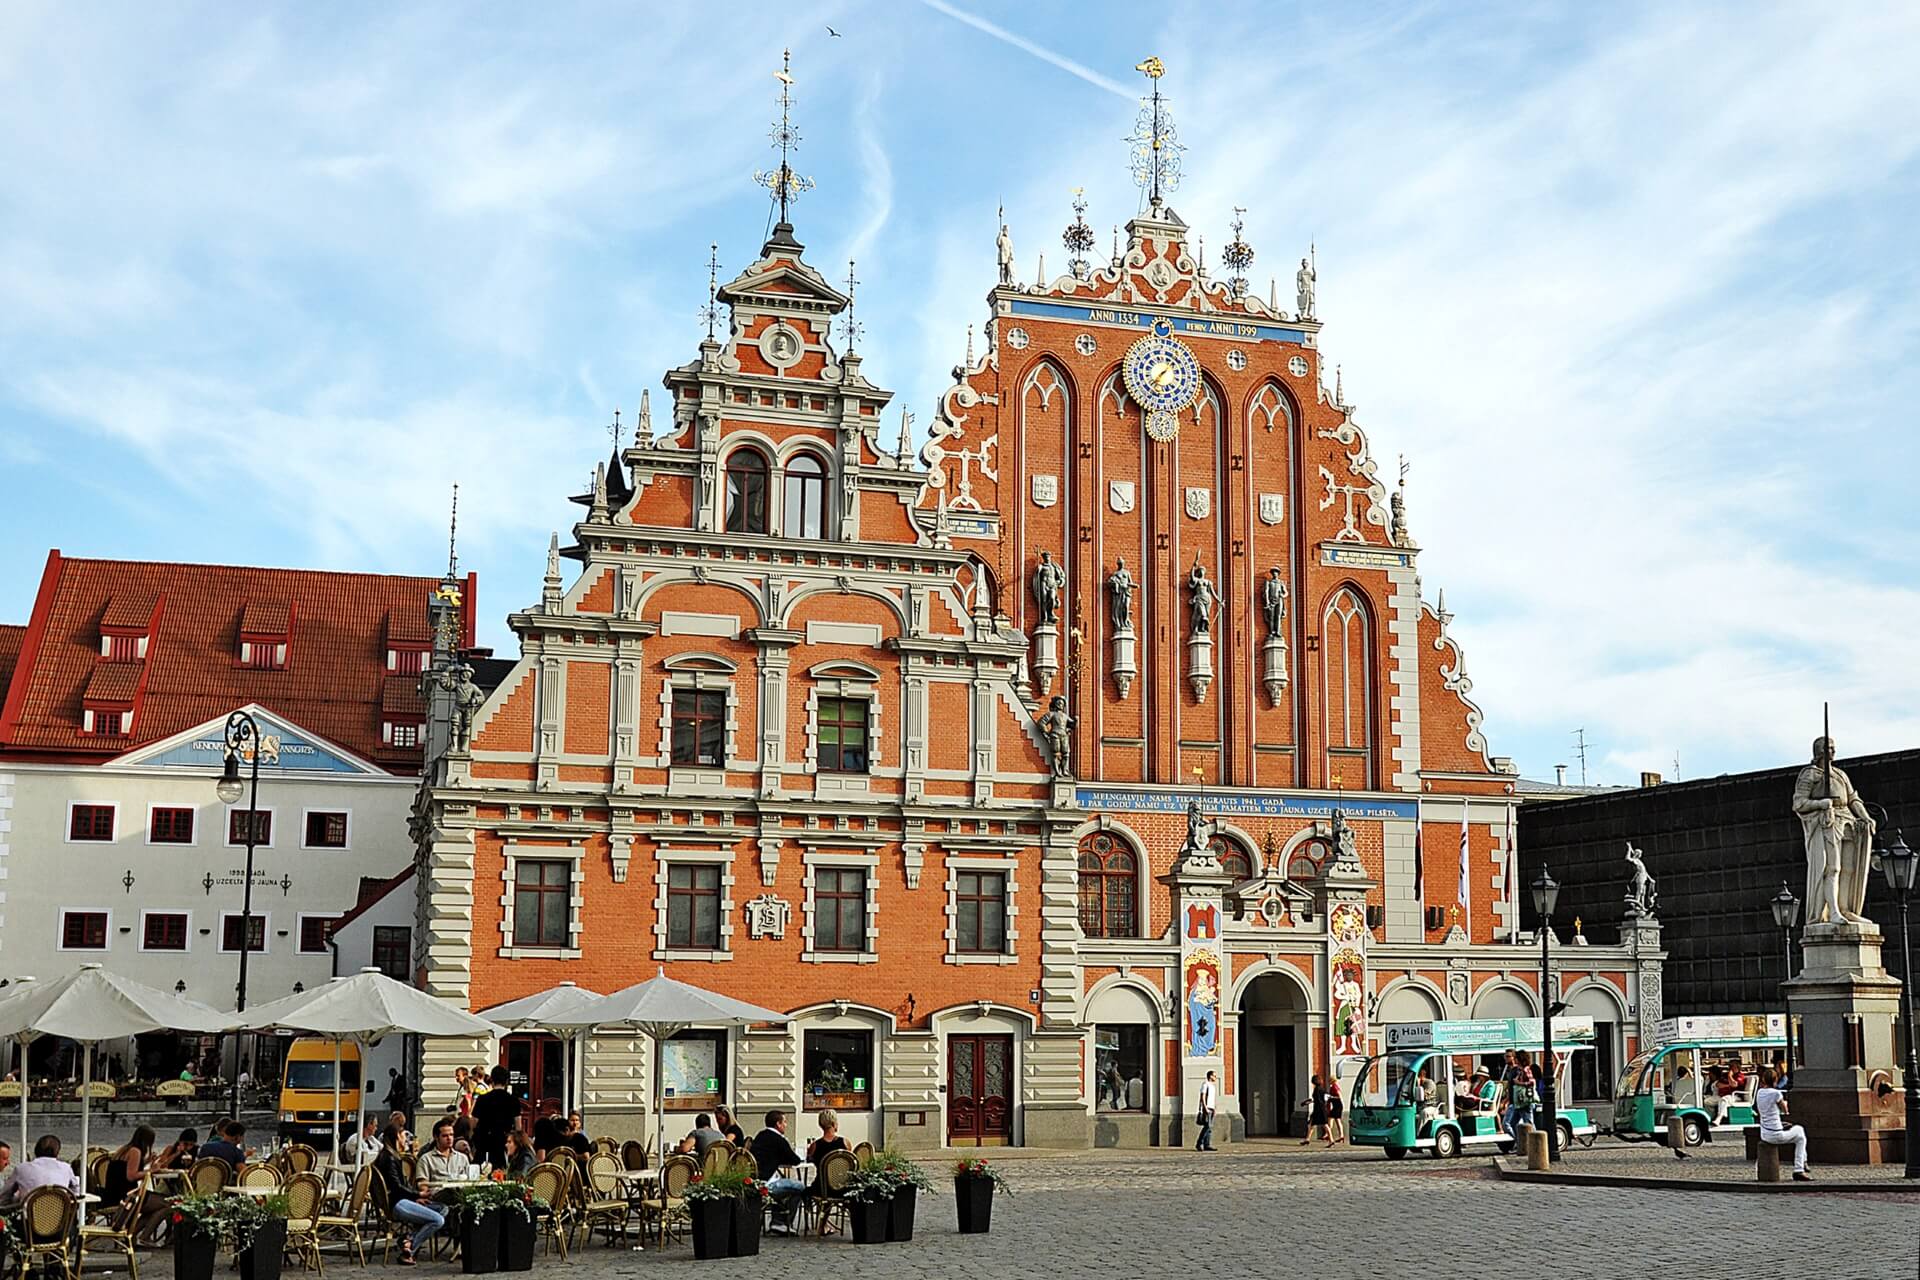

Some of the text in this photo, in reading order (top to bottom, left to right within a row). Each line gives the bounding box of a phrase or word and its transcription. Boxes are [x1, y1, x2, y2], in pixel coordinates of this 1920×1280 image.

[1088, 309, 1140, 325] ANNO 1334
[1209, 322, 1235, 334] ANNO
[1237, 325, 1257, 337] 1999
[1149, 795, 1172, 803] NAMS
[1135, 801, 1160, 809] NAMU
[1164, 802, 1175, 810] UZ
[1280, 807, 1305, 815] JAUNA
